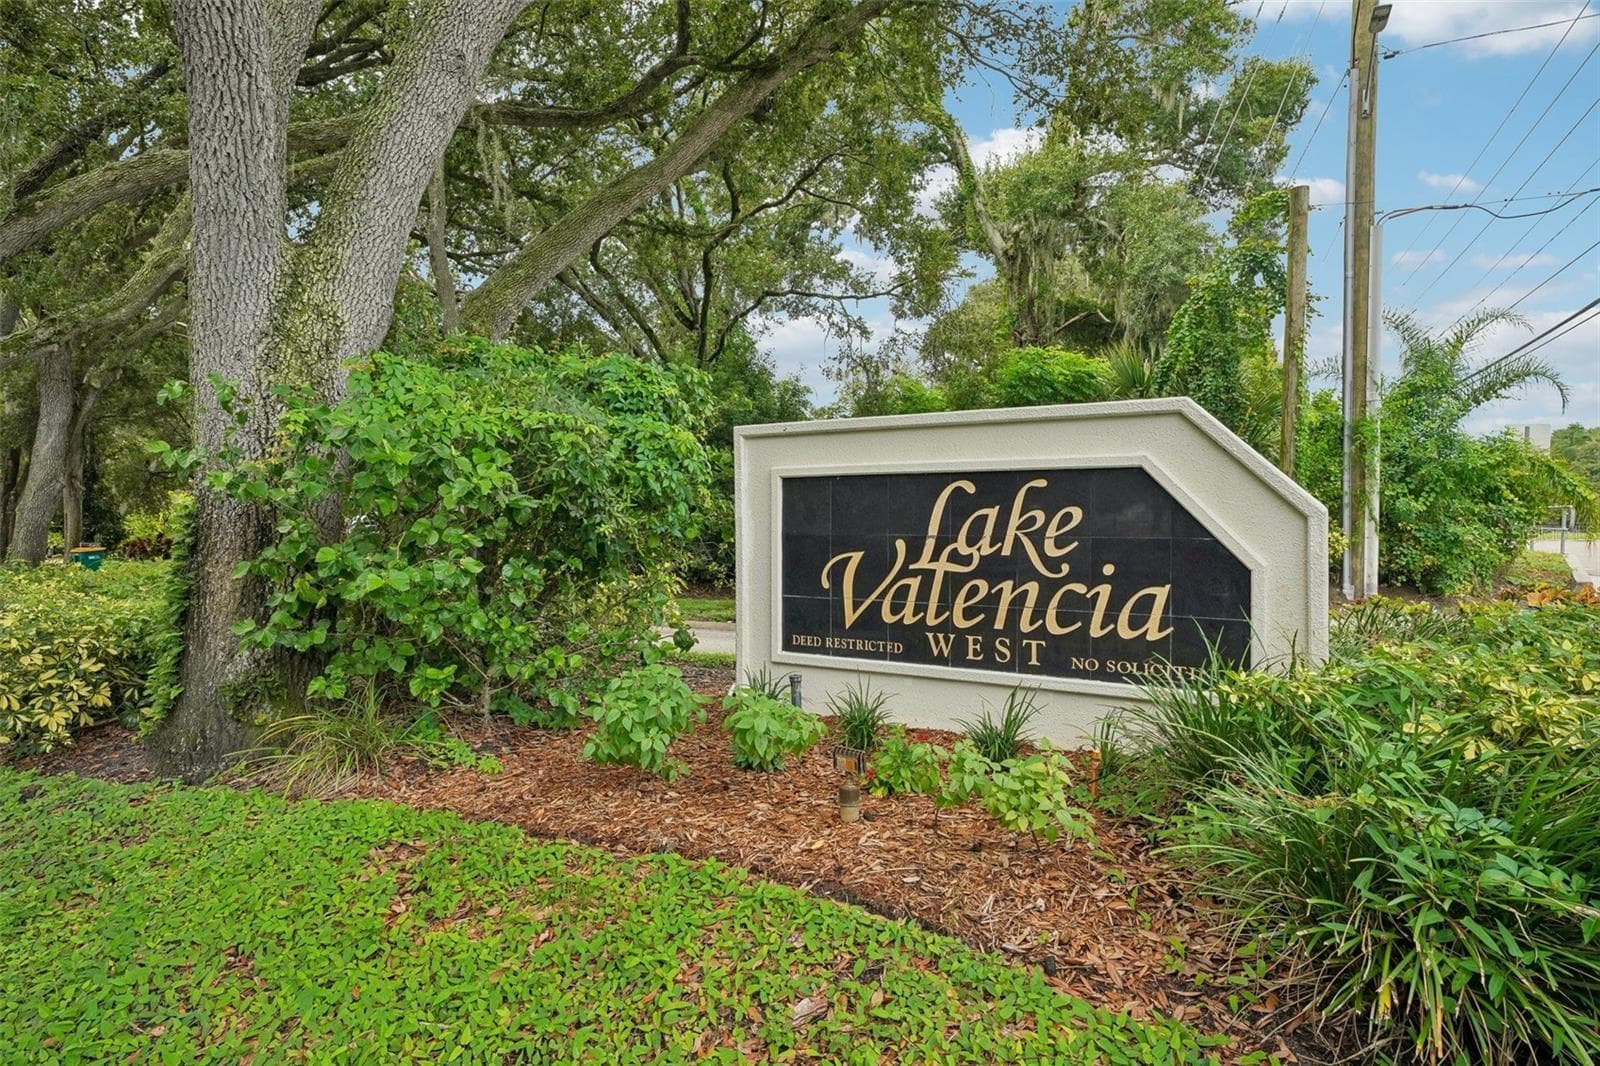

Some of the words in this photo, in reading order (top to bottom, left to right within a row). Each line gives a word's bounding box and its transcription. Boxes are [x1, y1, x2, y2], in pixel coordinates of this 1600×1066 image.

[909, 478, 1083, 577] Lake
[821, 538, 1174, 641] Valencia
[792, 634, 822, 647] DEED
[825, 637, 903, 654] RESTRICTED
[925, 632, 1047, 666] WEST
[1071, 657, 1099, 672] NO
